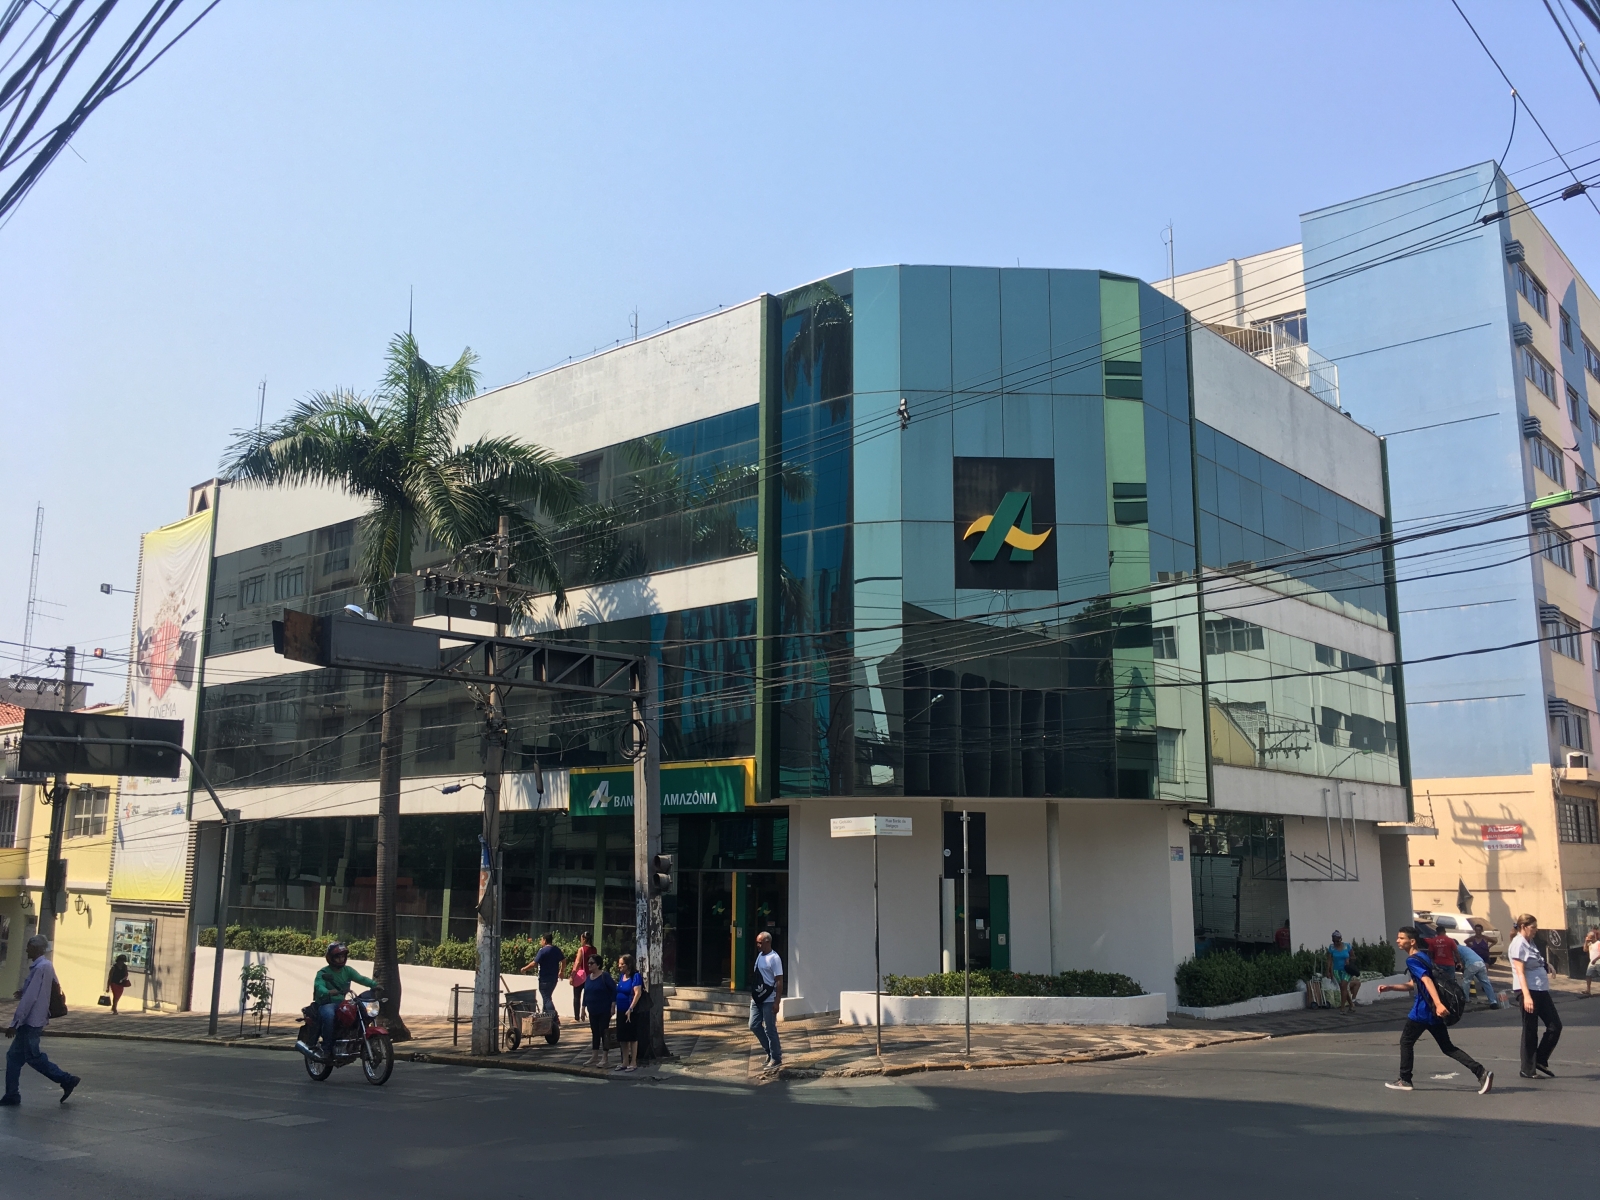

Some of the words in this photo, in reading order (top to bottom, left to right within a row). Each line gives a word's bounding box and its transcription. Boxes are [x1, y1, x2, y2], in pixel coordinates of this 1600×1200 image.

[148, 702, 177, 718] CINEMA
[613, 795, 634, 807] BAN
[663, 790, 718, 805] AMAZÔNIA
